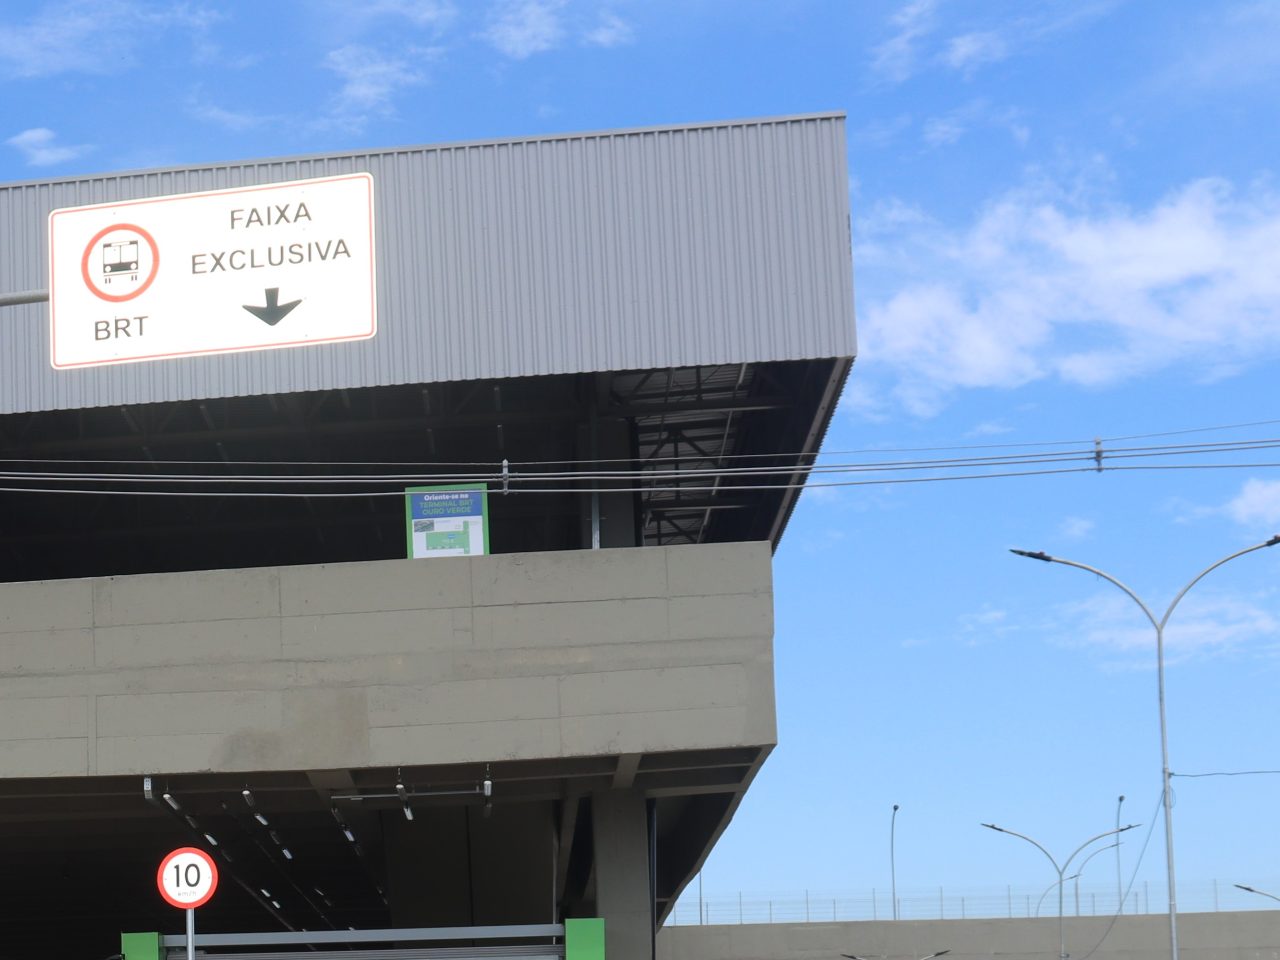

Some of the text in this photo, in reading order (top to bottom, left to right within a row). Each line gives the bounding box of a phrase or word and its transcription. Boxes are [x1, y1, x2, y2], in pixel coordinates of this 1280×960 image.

[230, 202, 312, 229] FAIXA
[191, 238, 351, 275] EXCLUSIVA
[94, 315, 149, 341] BRT
[422, 507, 444, 515] OURO
[174, 863, 200, 888] 10
